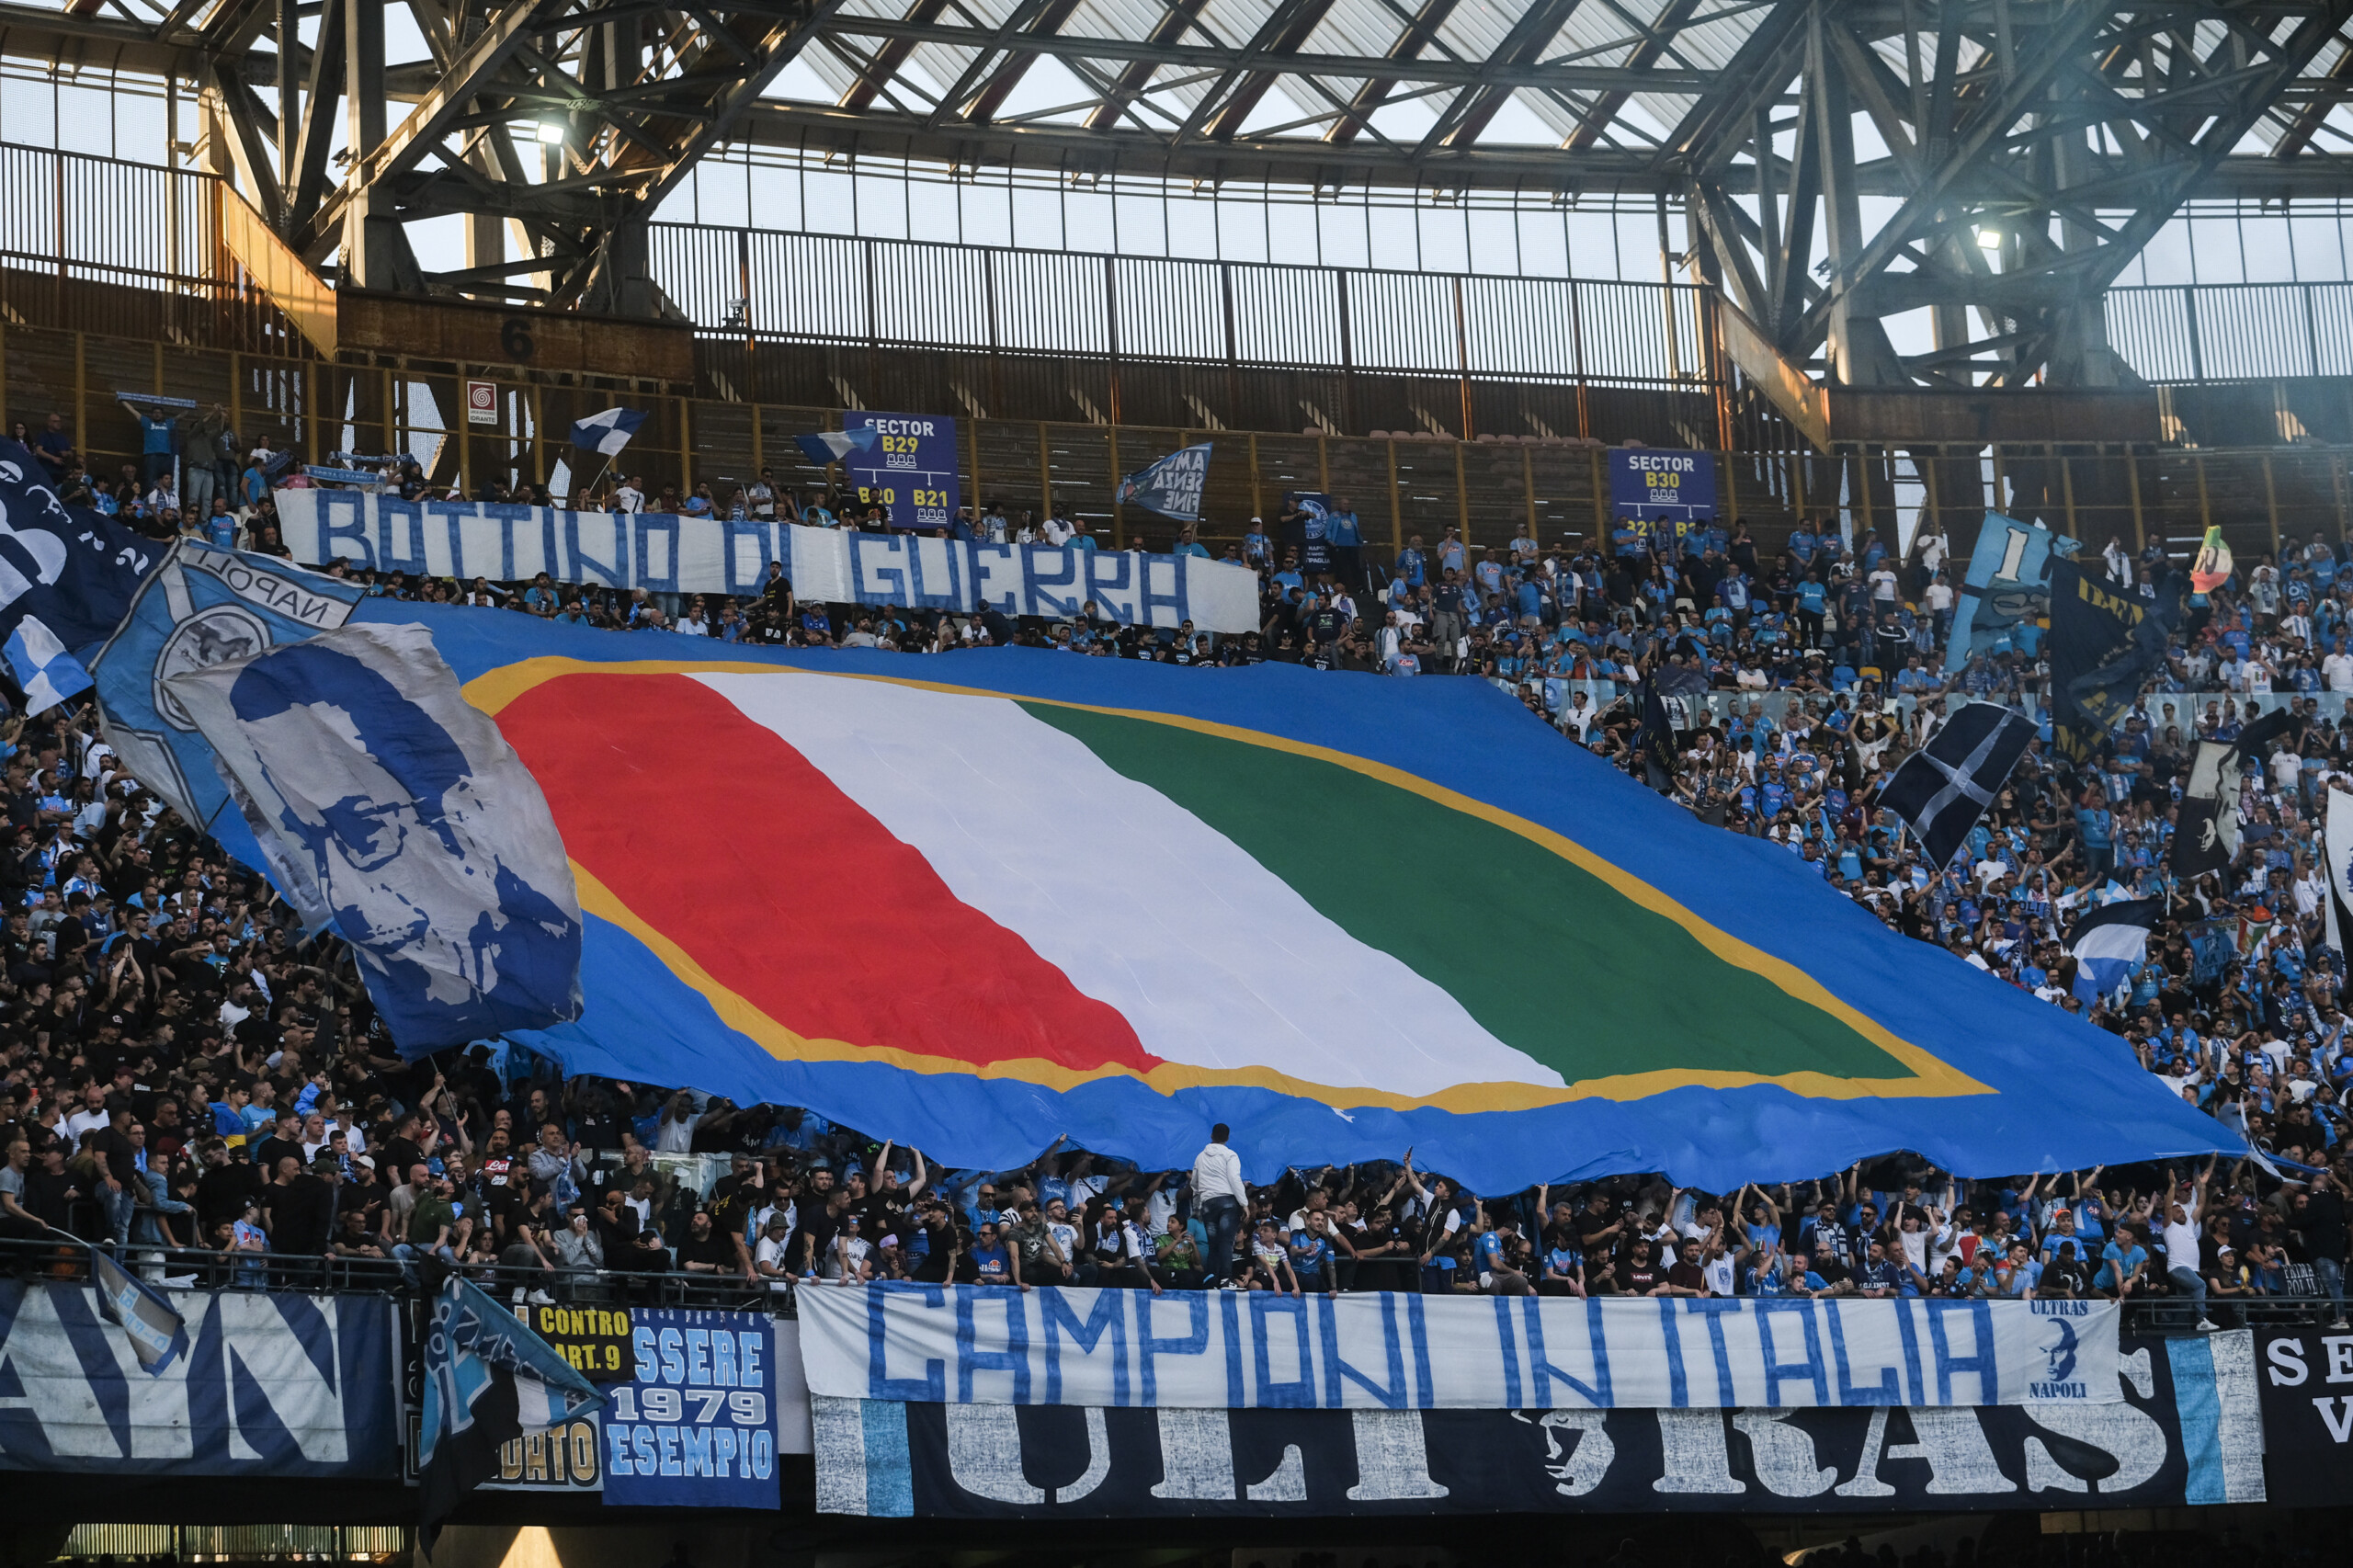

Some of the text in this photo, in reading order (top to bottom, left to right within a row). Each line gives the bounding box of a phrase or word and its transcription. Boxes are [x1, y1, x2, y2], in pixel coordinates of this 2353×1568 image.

[501, 318, 534, 363] 6
[865, 418, 935, 437] SECTOR
[882, 436, 919, 453] B29
[1629, 456, 1695, 472] SECTOR
[1645, 472, 1680, 488] B30
[858, 486, 895, 505] B0
[913, 489, 948, 507] B21
[315, 488, 680, 594] BOTTINO
[847, 530, 1193, 630] GUERRA
[485, 1160, 510, 1171] Let
[540, 1307, 630, 1336] CONTRO
[2029, 1300, 2088, 1316] ULTRAS
[605, 1345, 620, 1370] 9
[632, 1326, 763, 1388] SSERE
[868, 1280, 1998, 1409] CAMPIONI IN ITALIA
[0, 1286, 349, 1462] AYN
[2029, 1382, 2087, 1398] NAPOLI
[610, 1387, 767, 1425] 1979
[2312, 1395, 2353, 1443] V
[492, 1422, 597, 1482] DATO
[606, 1424, 773, 1480] ESEMPIO
